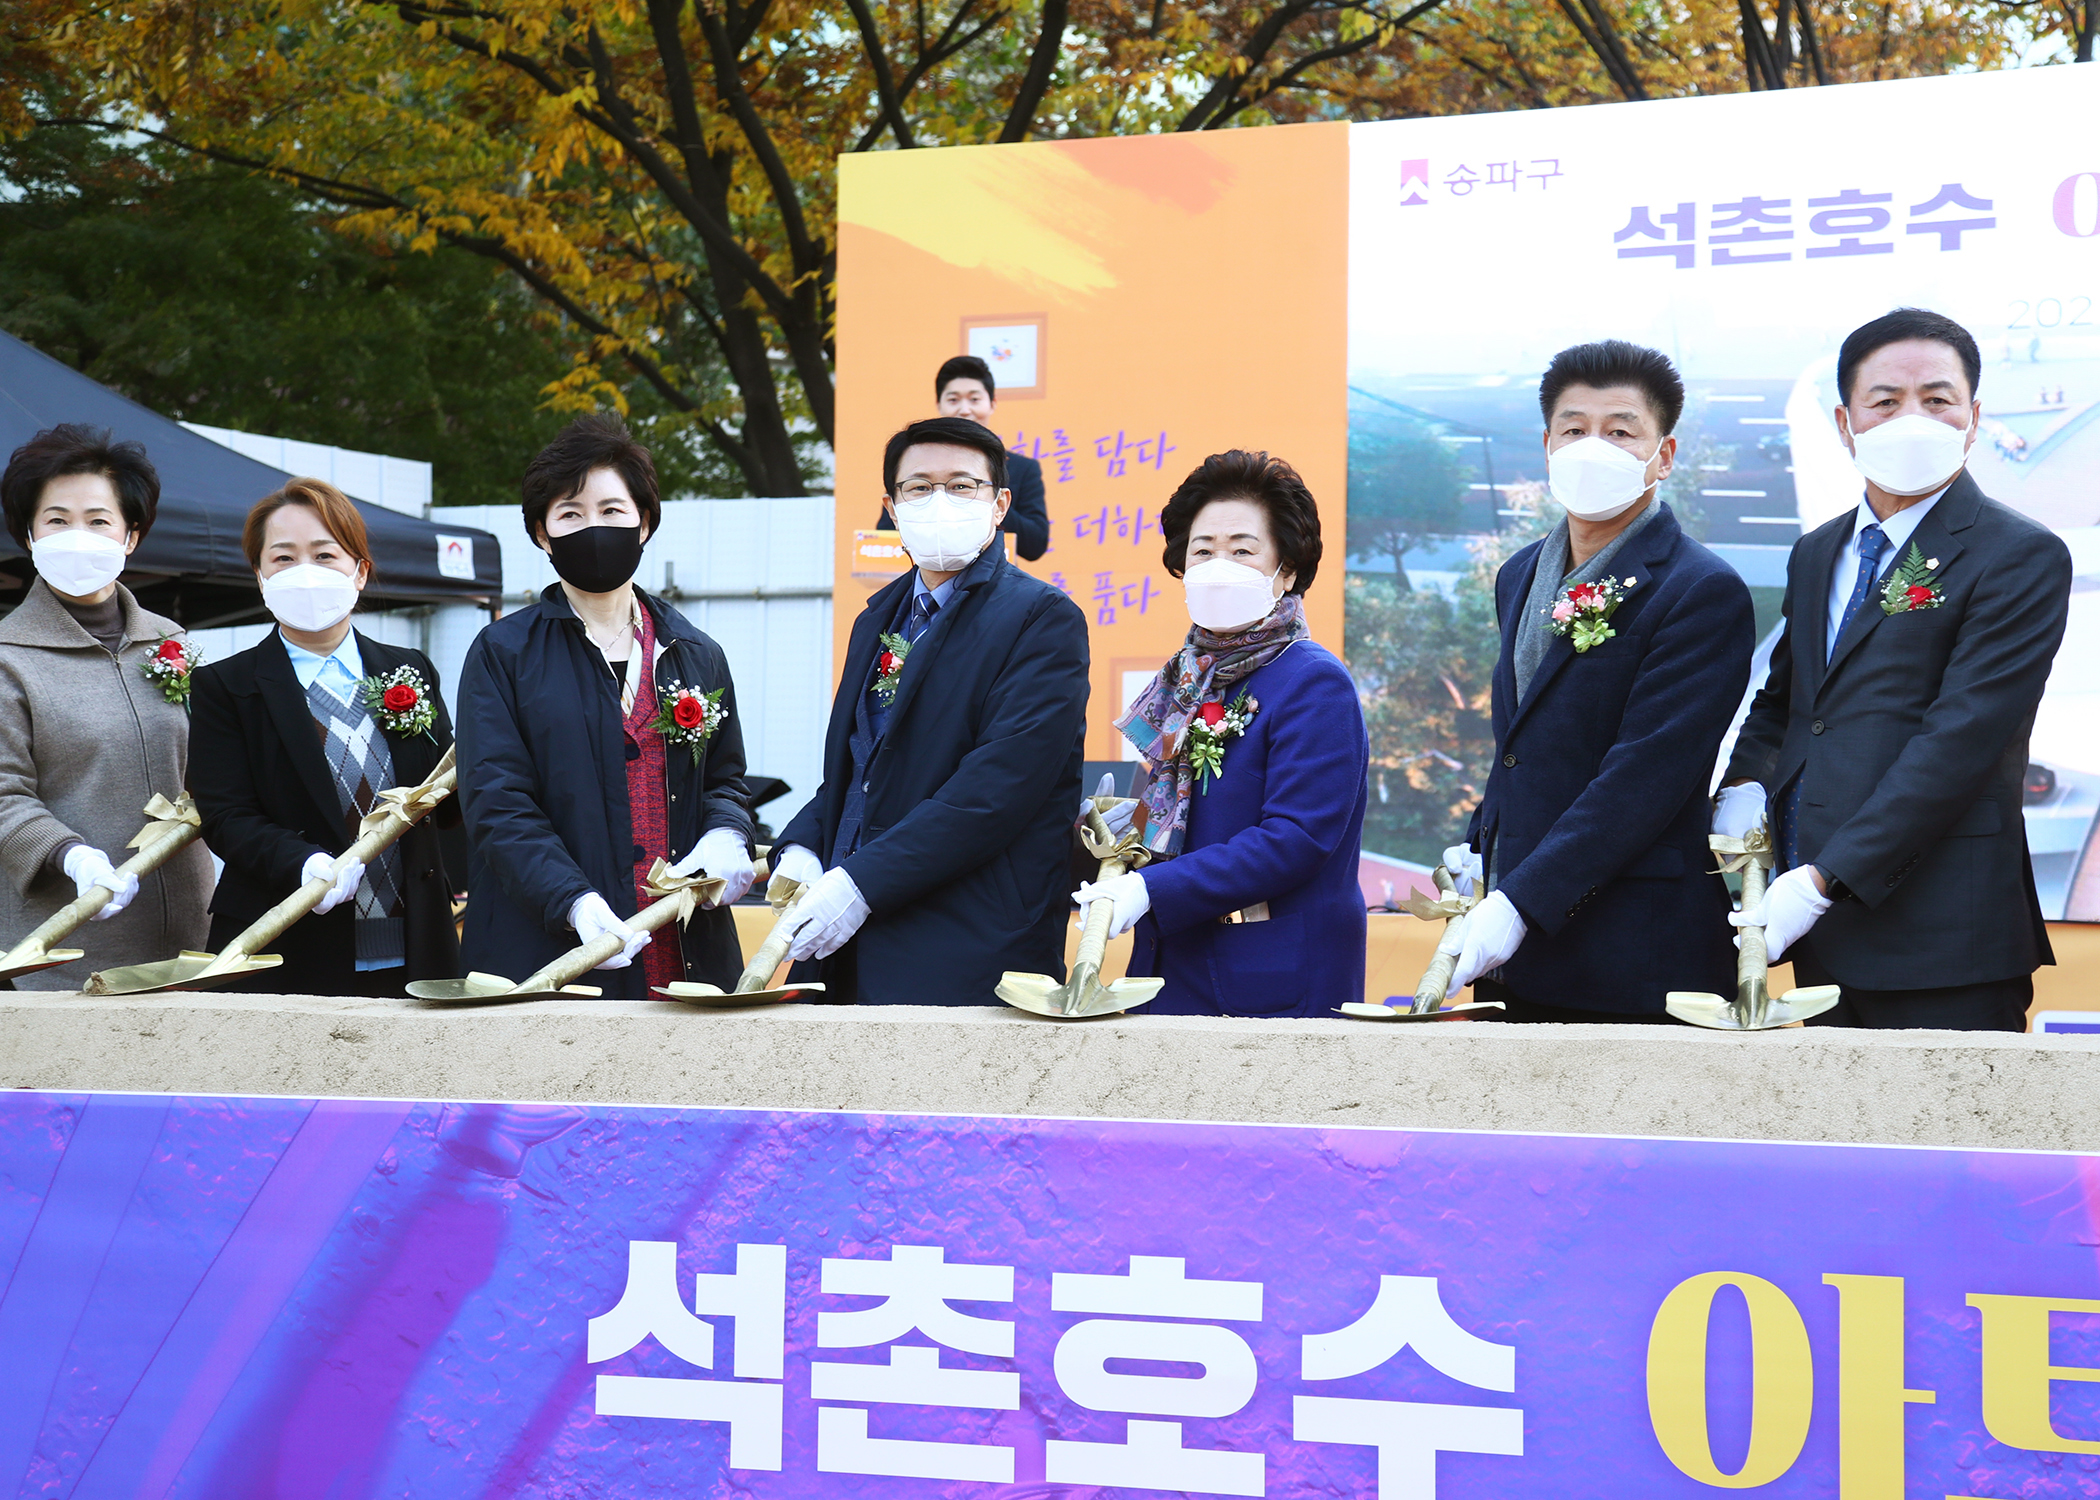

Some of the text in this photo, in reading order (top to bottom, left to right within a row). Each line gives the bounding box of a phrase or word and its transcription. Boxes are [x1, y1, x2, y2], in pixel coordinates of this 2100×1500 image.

[1443, 158, 1564, 196] 송파구
[1613, 183, 1997, 269] 석촌호수
[1094, 430, 1177, 477] 담다
[1073, 505, 1164, 546] 더하
[1093, 571, 1161, 625] 품다
[587, 1240, 1524, 1500] 석촌호수
